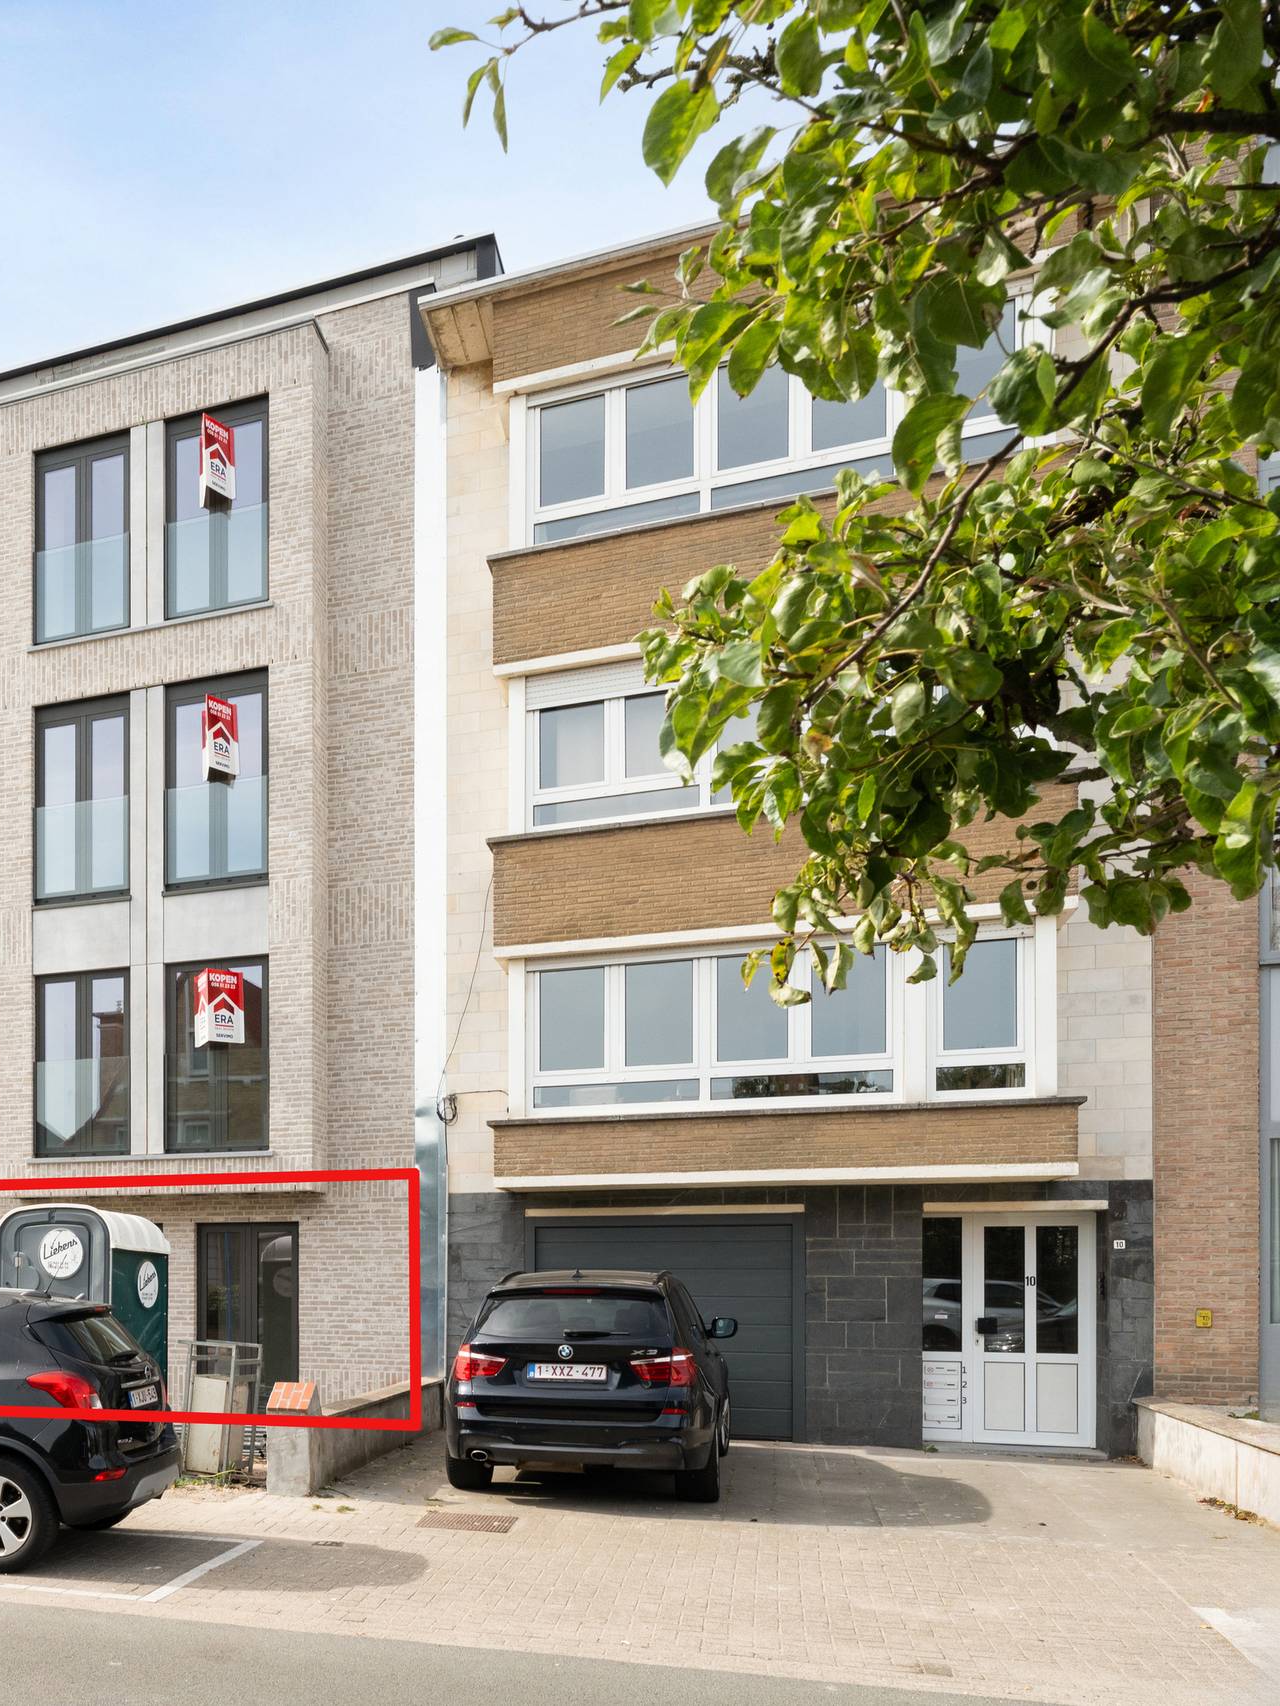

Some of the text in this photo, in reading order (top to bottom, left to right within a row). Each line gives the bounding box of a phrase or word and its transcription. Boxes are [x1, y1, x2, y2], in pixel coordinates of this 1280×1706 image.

[205, 418, 228, 440] KOPEN
[210, 461, 226, 477] ERA
[208, 700, 231, 716] KOPEN
[213, 742, 229, 755] ERA
[209, 973, 237, 984] KOPEN
[214, 1014, 234, 1024] ERA
[1025, 1276, 1036, 1286] 10
[962, 1366, 967, 1374] 1
[962, 1396, 967, 1404] 3
